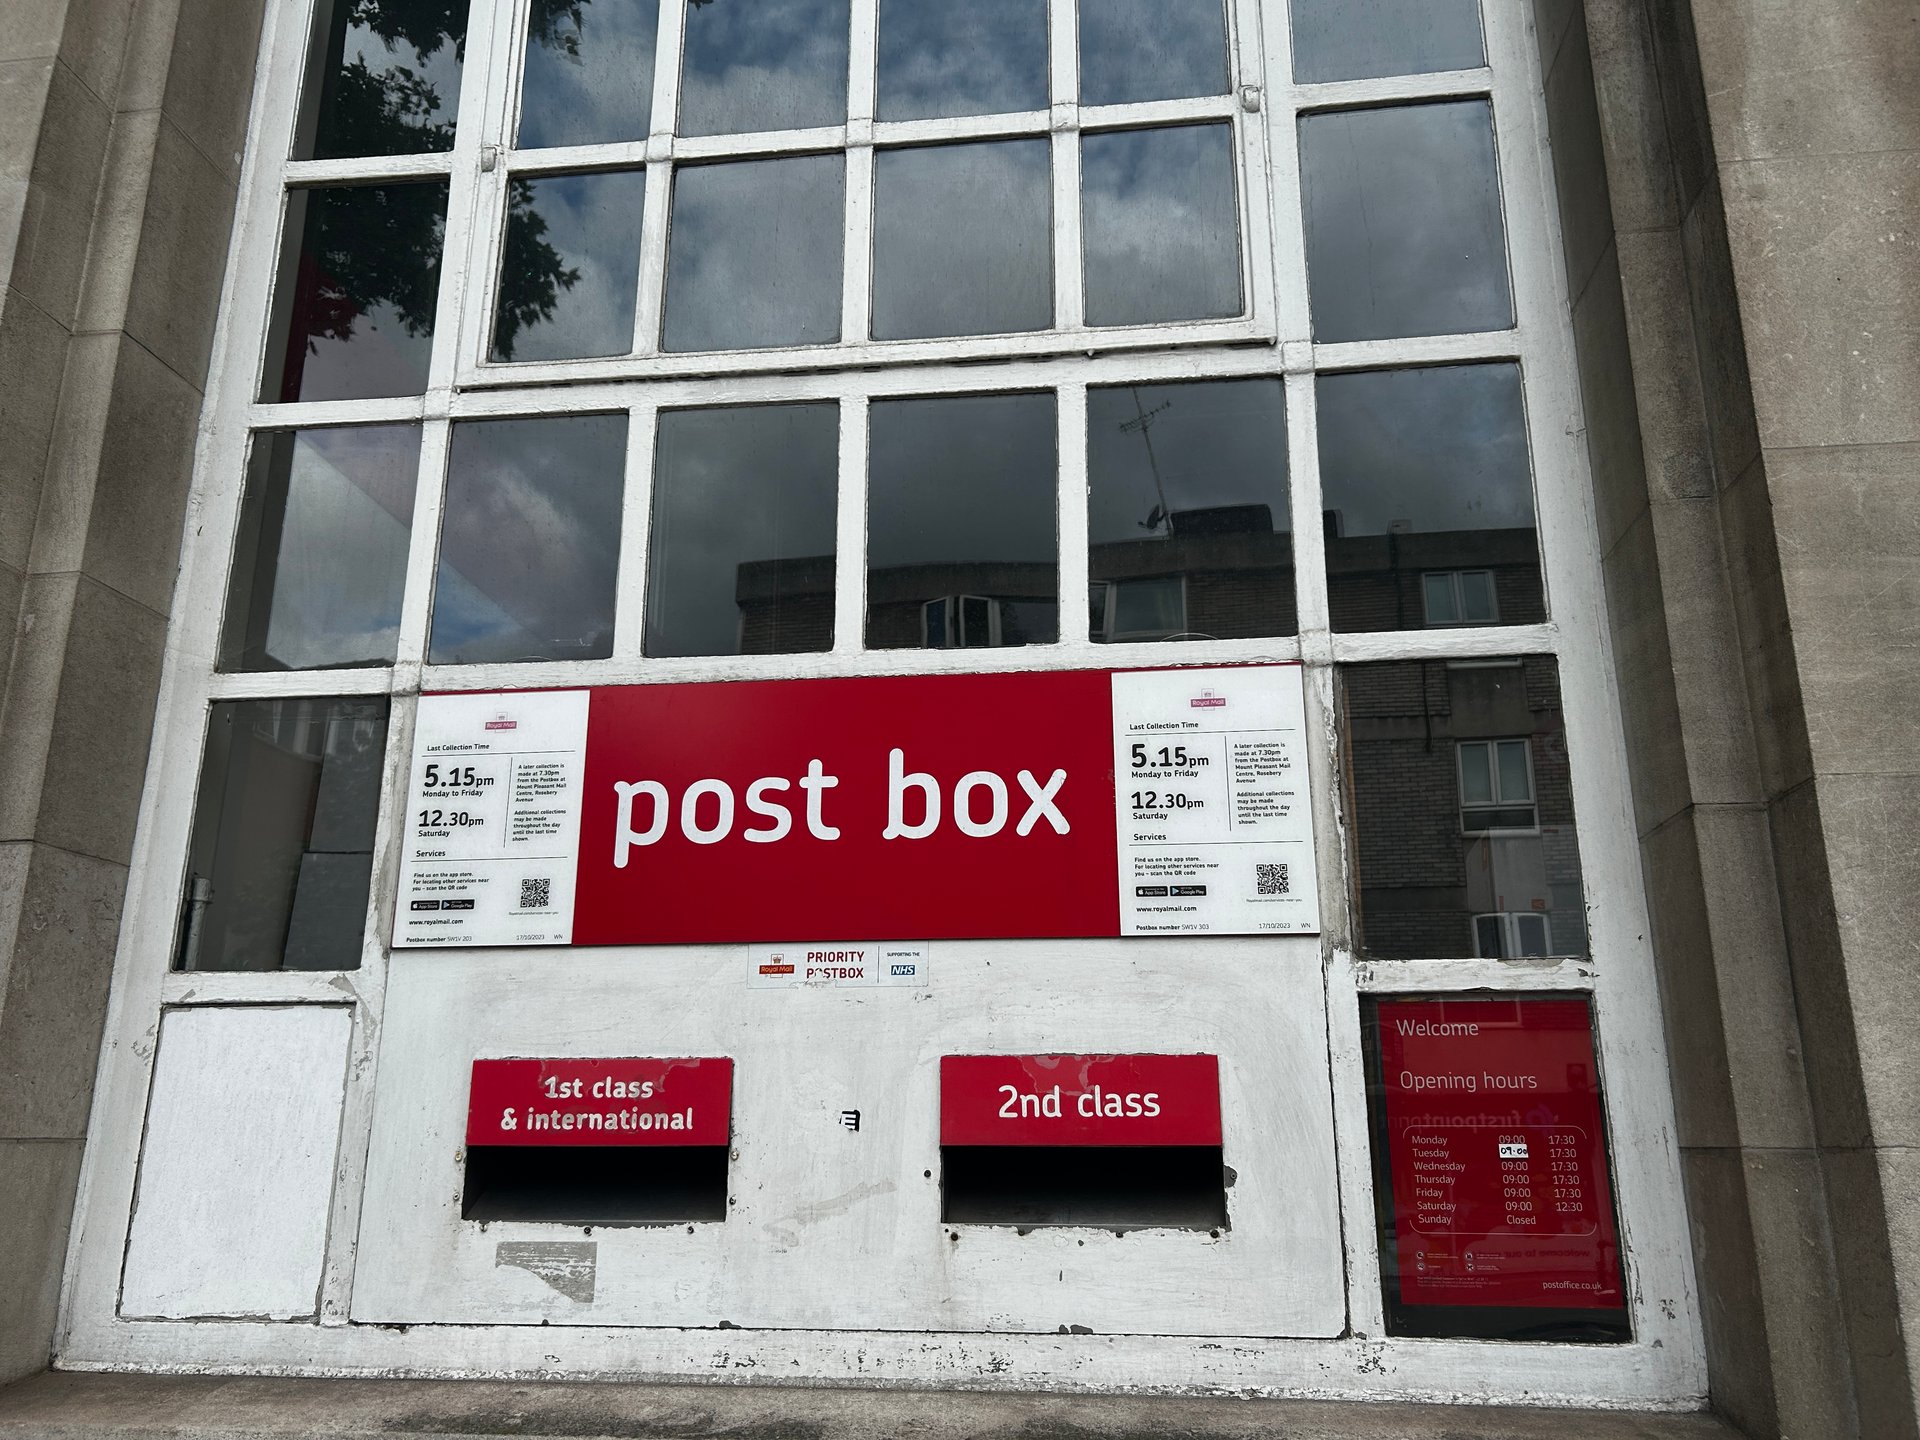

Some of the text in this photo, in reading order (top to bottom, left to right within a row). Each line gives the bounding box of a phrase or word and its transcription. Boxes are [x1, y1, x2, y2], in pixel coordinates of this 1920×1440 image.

[1146, 722, 1179, 730] Collection
[1131, 743, 1209, 768] 5.15pm
[423, 763, 495, 789] 5.15pm
[1131, 770, 1161, 779] Monday
[1174, 769, 1198, 778] Friday
[422, 790, 450, 798] Monday
[461, 789, 483, 797] Friday
[1130, 791, 1205, 810] 12.30pm
[613, 748, 1071, 868] post box
[418, 810, 484, 828] 12.30pm
[1132, 811, 1168, 821] Saturday
[418, 829, 450, 838] Saturday
[1133, 832, 1166, 841] Services
[415, 849, 445, 857] Services
[442, 878, 456, 886] other
[1135, 905, 1197, 913] www.royalmail.com
[408, 918, 463, 926] www.royalmail.com
[807, 951, 865, 963] PRIORITY
[761, 965, 793, 974] Royal Mail
[892, 965, 915, 975] NHS
[1396, 1019, 1478, 1036] Welcome
[543, 1075, 654, 1099] 1st class
[1400, 1070, 1537, 1093] Opening hours
[998, 1084, 1161, 1118] 2nd class
[500, 1106, 694, 1132] & international
[1411, 1134, 1575, 1146] Monday 09:00 17:30
[1411, 1148, 1576, 1160] Tuesday 17:30
[1413, 1161, 1578, 1172] Wednesday 09:00 17:30
[1414, 1174, 1579, 1186] Thursday 09:00 17:30
[1415, 1187, 1581, 1199] Friday 09:00 17:30
[1416, 1200, 1582, 1213] Saturday 09:00 12:30
[1417, 1213, 1536, 1225] Sunday Closed
[1542, 1280, 1602, 1291] postoffice.co.uk
